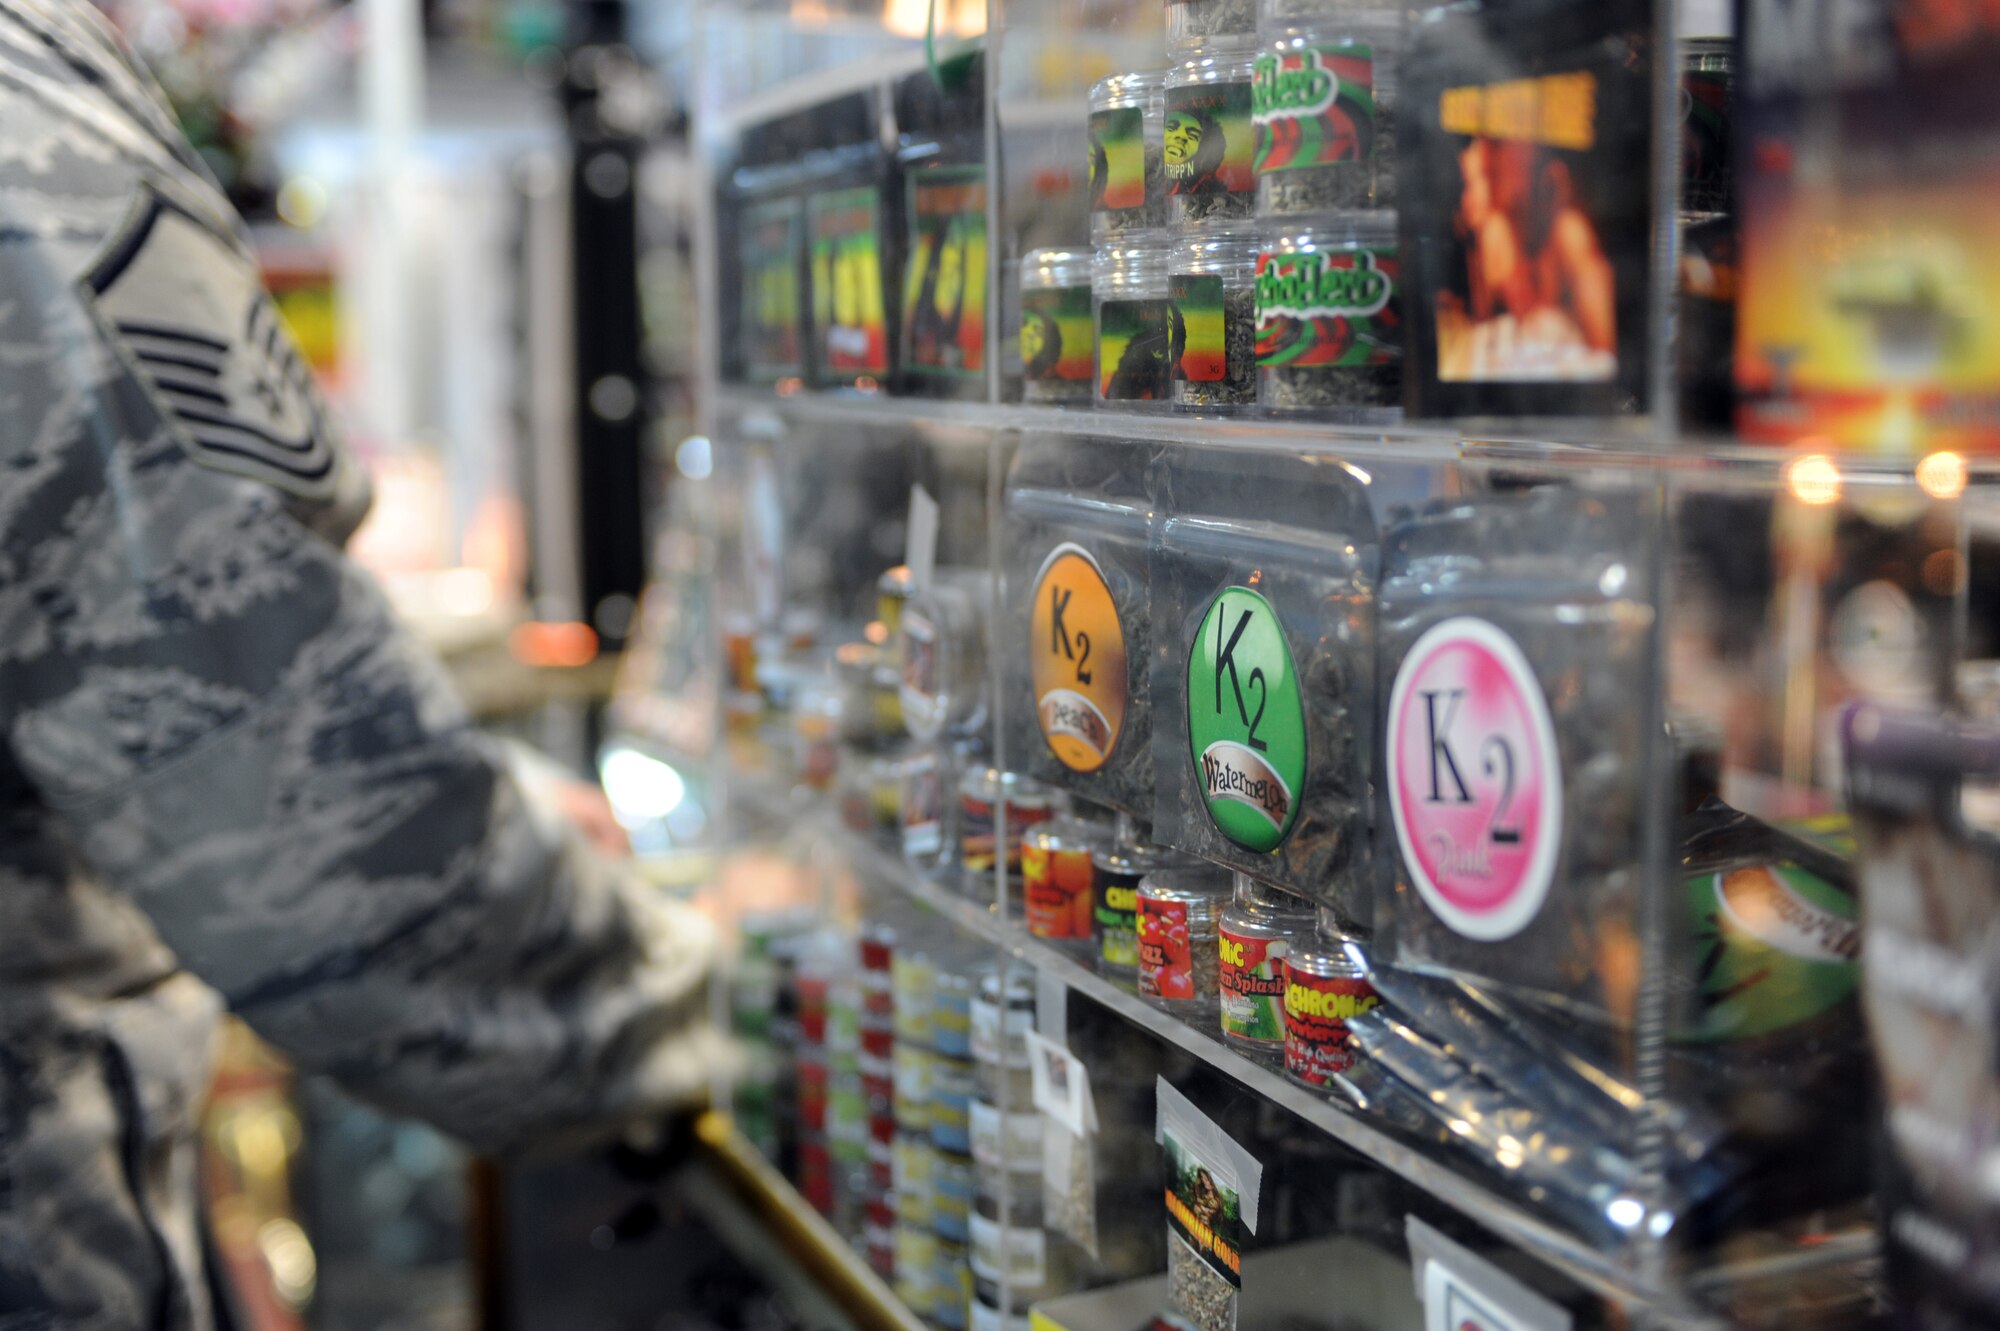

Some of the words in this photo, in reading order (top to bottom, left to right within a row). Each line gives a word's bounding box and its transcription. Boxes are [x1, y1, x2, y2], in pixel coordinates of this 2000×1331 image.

[1052, 585, 1092, 685] K2
[1215, 602, 1267, 752] K2
[1419, 688, 1521, 843] K2
[1235, 971, 1285, 995] Splash
